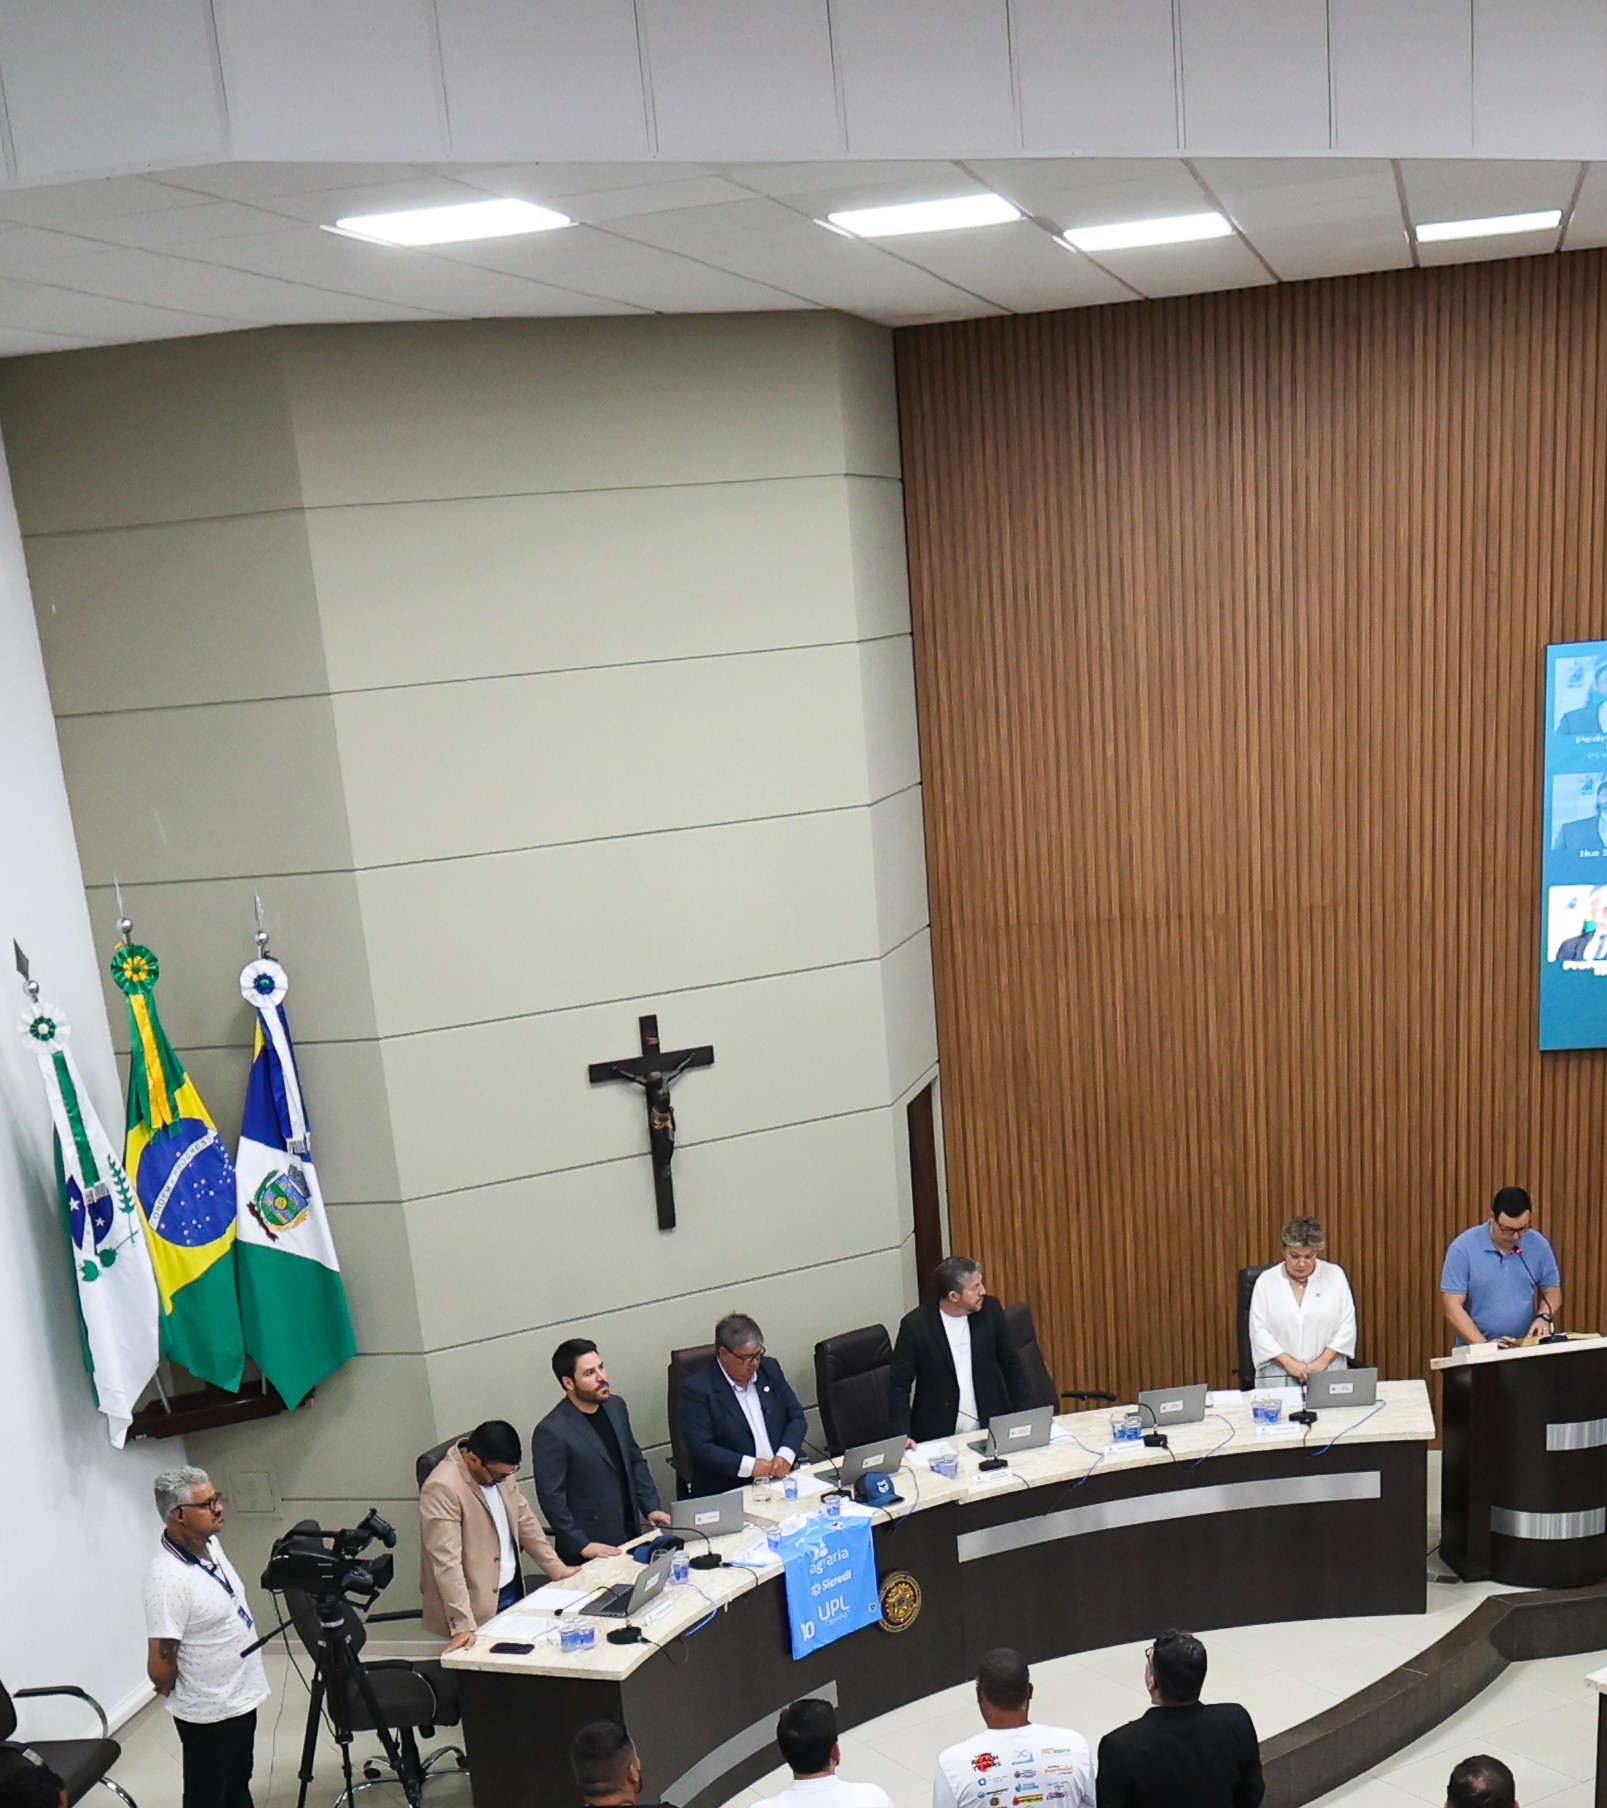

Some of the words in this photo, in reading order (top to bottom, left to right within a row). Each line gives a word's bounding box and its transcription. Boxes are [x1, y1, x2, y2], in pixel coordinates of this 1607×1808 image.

[1580, 849, 1600, 859] Ike
[153, 1185, 172, 1219] ORDEM
[821, 1568, 853, 1592] Sicredi
[818, 1595, 850, 1621] UPL
[800, 1620, 817, 1642] 10
